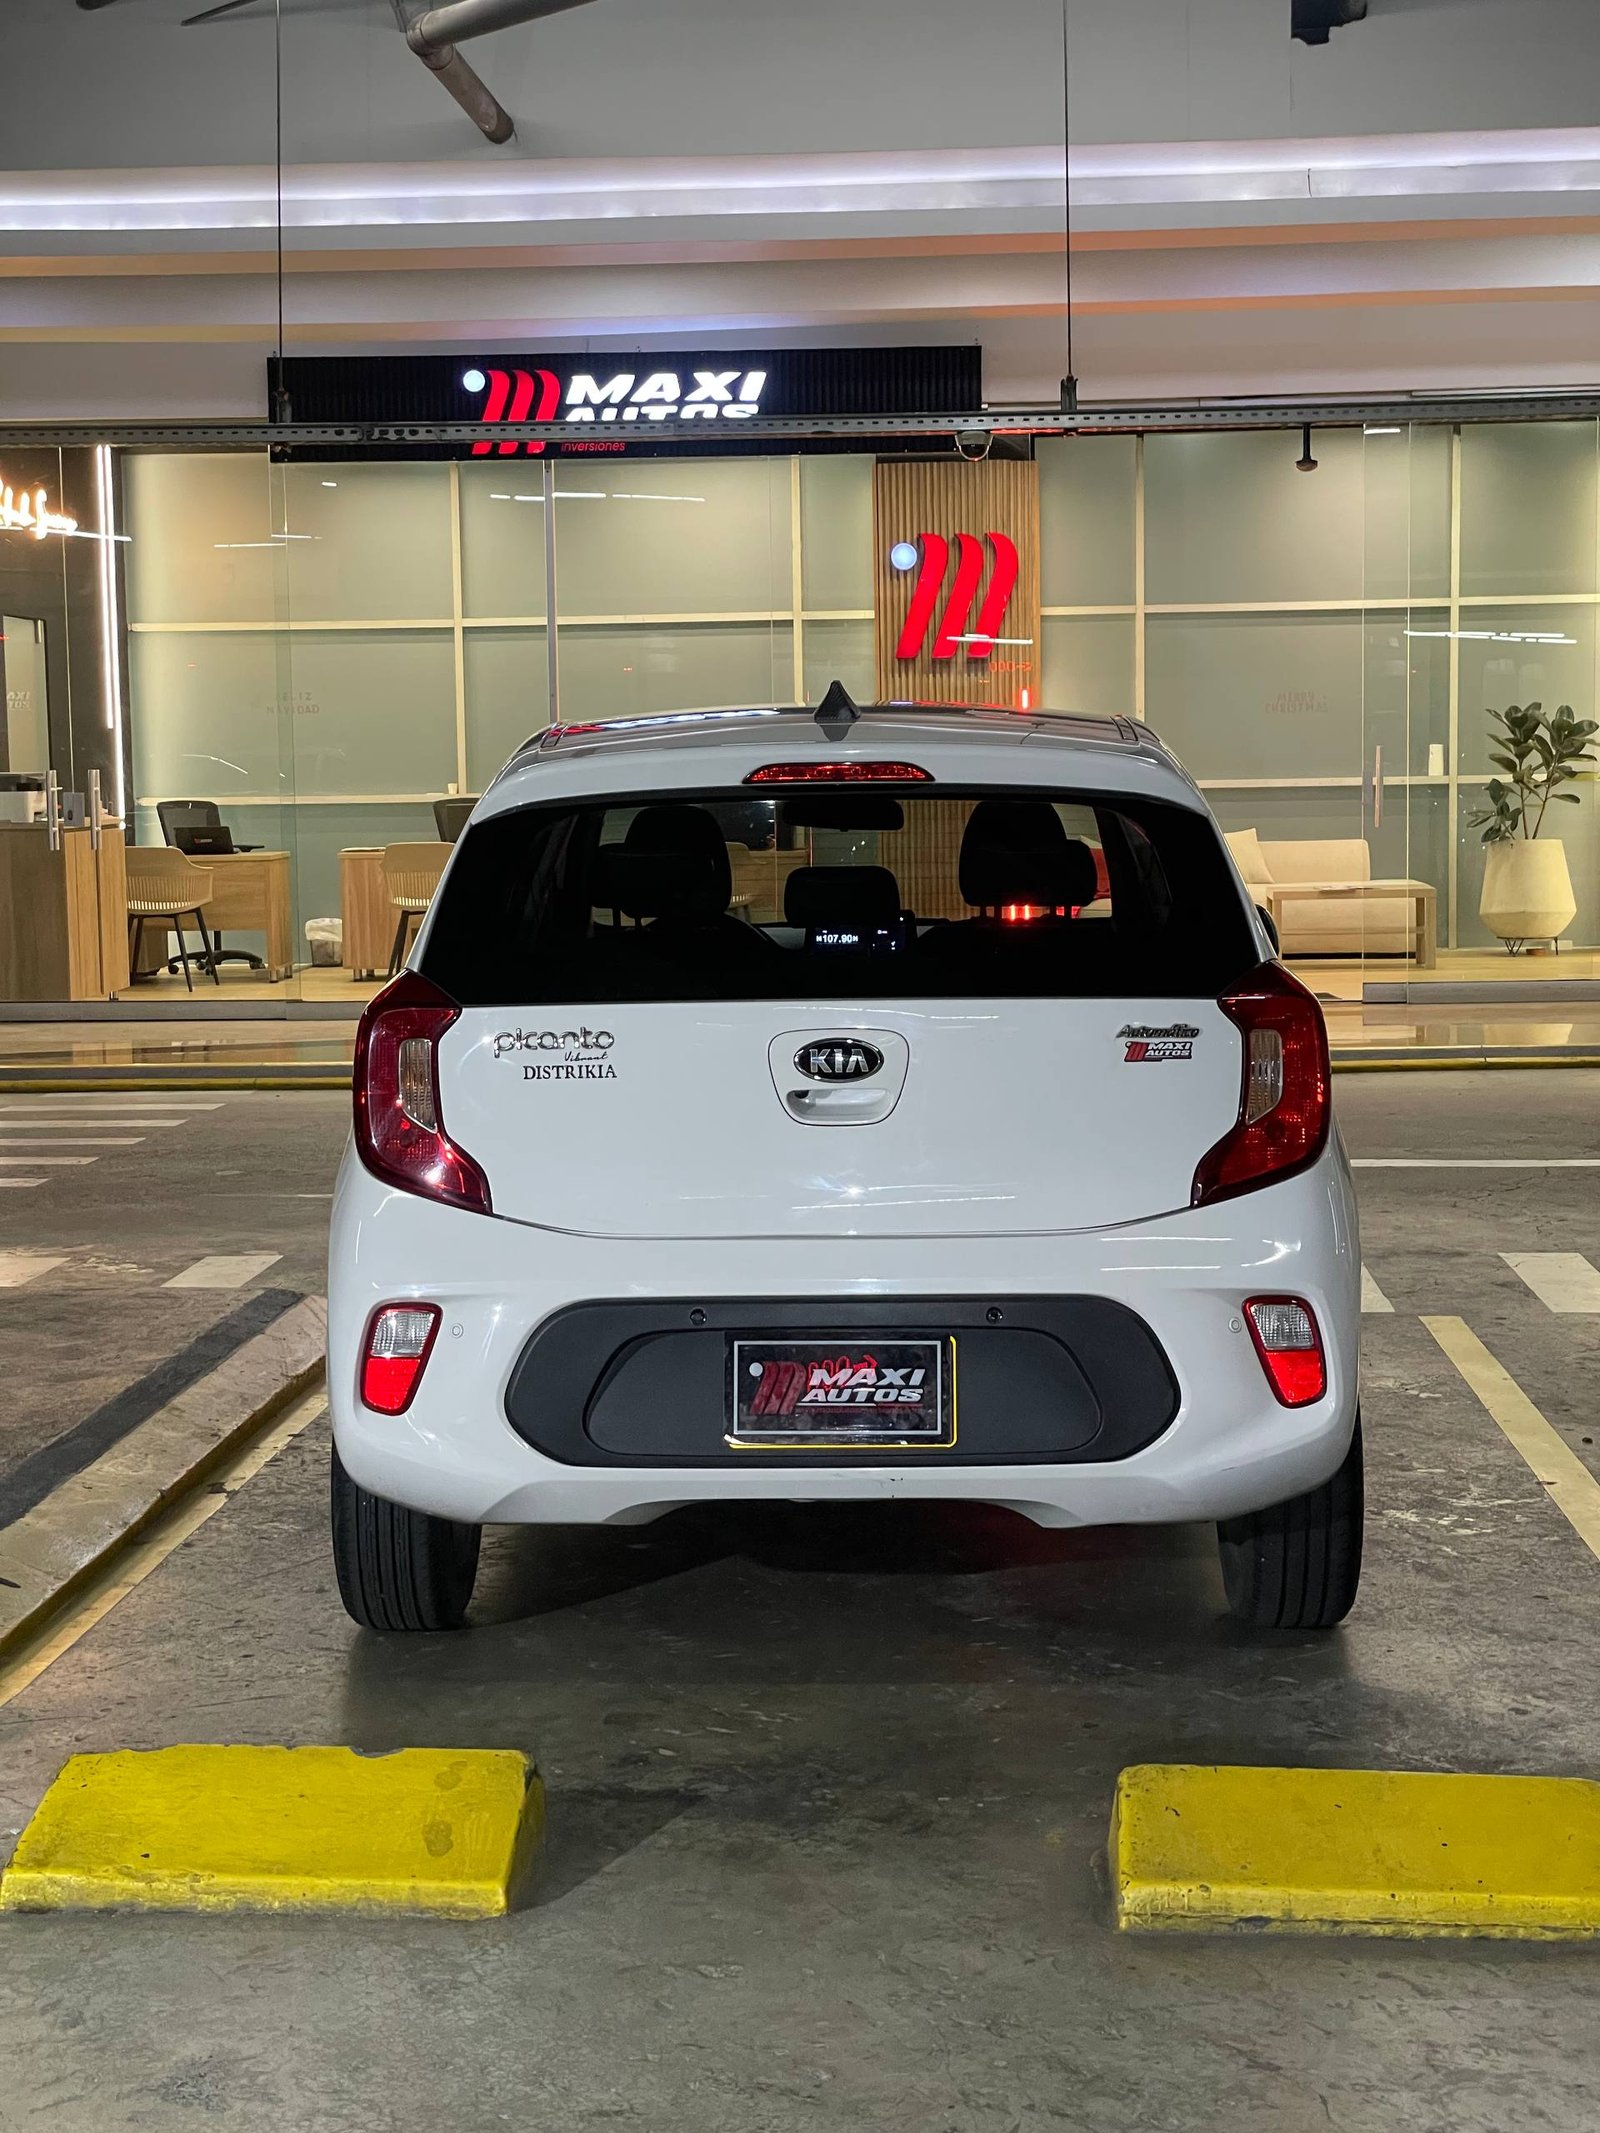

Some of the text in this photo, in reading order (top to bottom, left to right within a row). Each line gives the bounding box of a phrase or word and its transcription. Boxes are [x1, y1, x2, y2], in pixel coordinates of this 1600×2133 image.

[565, 371, 767, 405] MAXI
[561, 440, 626, 452] inversiones
[493, 1026, 615, 1059] picanto
[1147, 1042, 1192, 1050] MAXI
[564, 1051, 608, 1063] Vibrant
[809, 1048, 870, 1073] KIA
[523, 1064, 617, 1080] DISTRIKIA
[808, 1368, 926, 1386] MAXI
[800, 1387, 924, 1402] AUTOS
